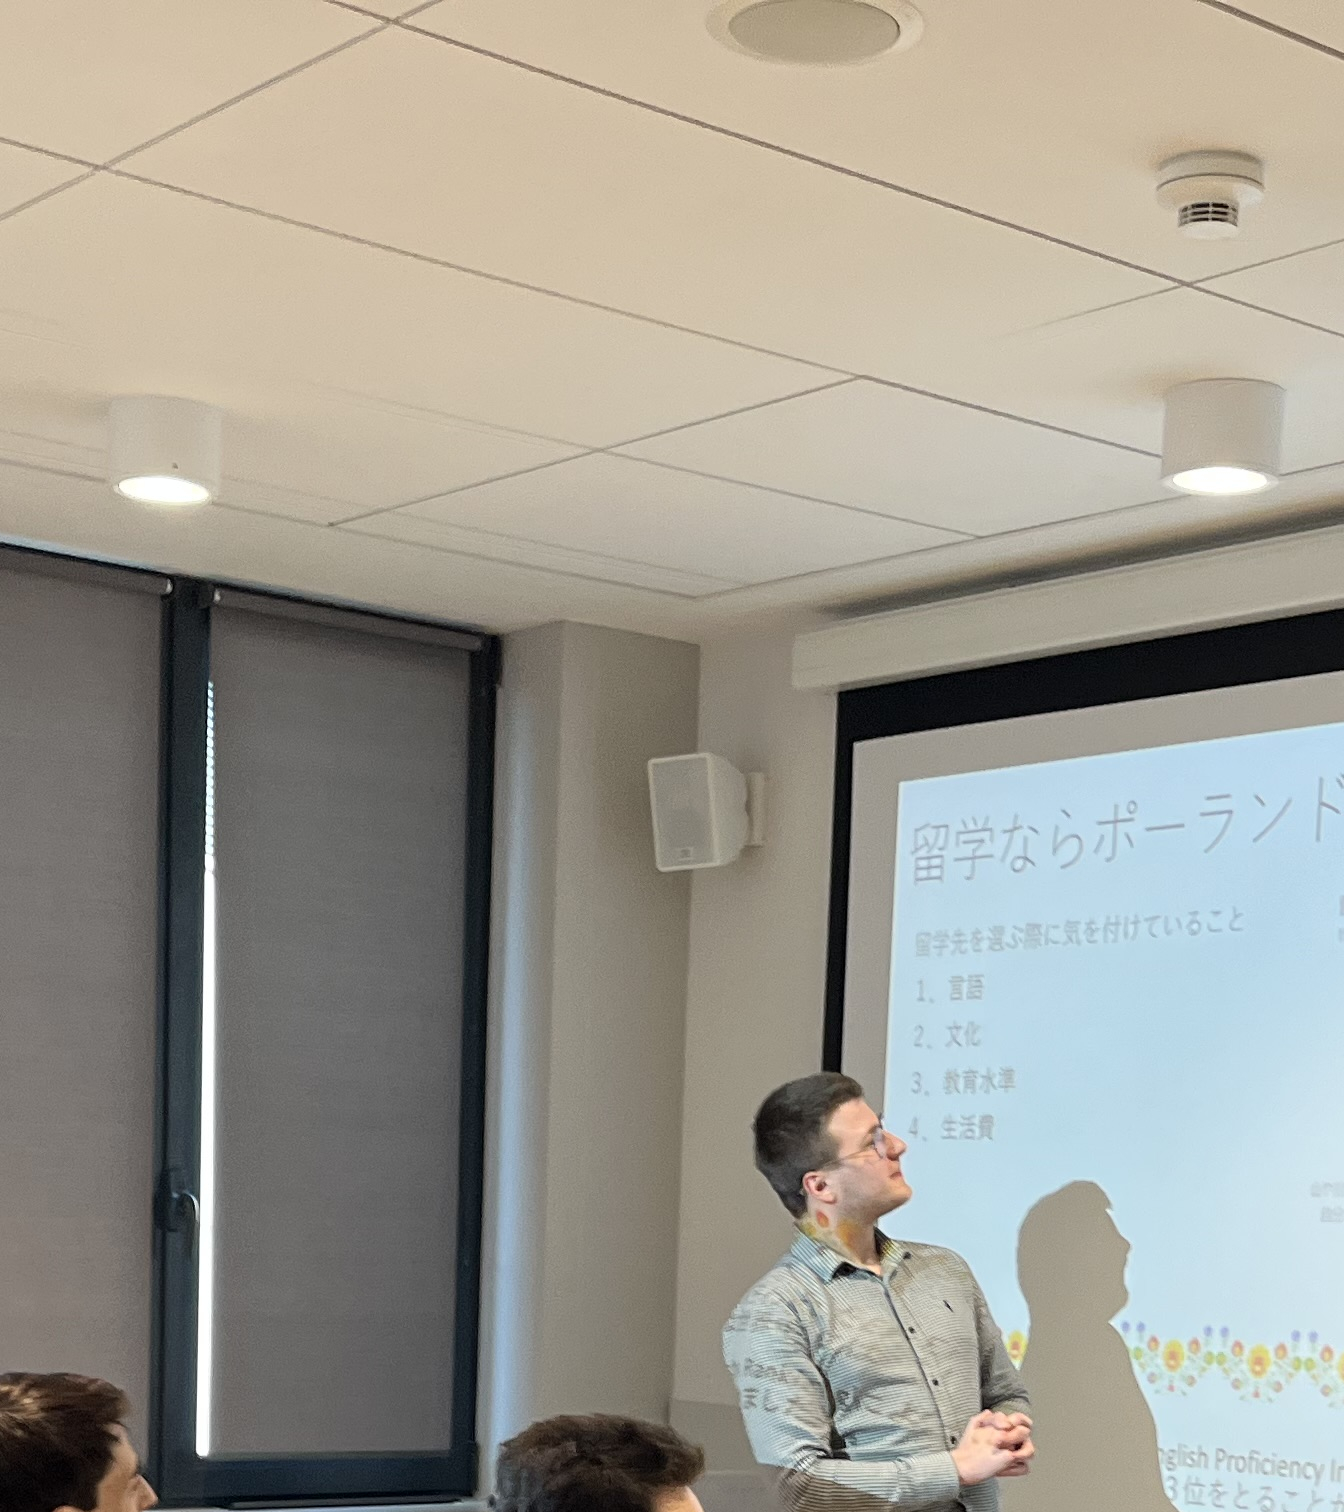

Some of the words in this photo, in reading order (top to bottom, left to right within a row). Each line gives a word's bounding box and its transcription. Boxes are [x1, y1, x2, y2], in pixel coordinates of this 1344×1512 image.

[915, 906, 1245, 957] 留学先を選ぶ際に気を付けていること
[945, 1020, 983, 1049] 文化
[940, 1114, 996, 1142] 生活費
[1158, 1443, 1208, 1471] nglish
[1215, 1447, 1325, 1486] Proficiency
